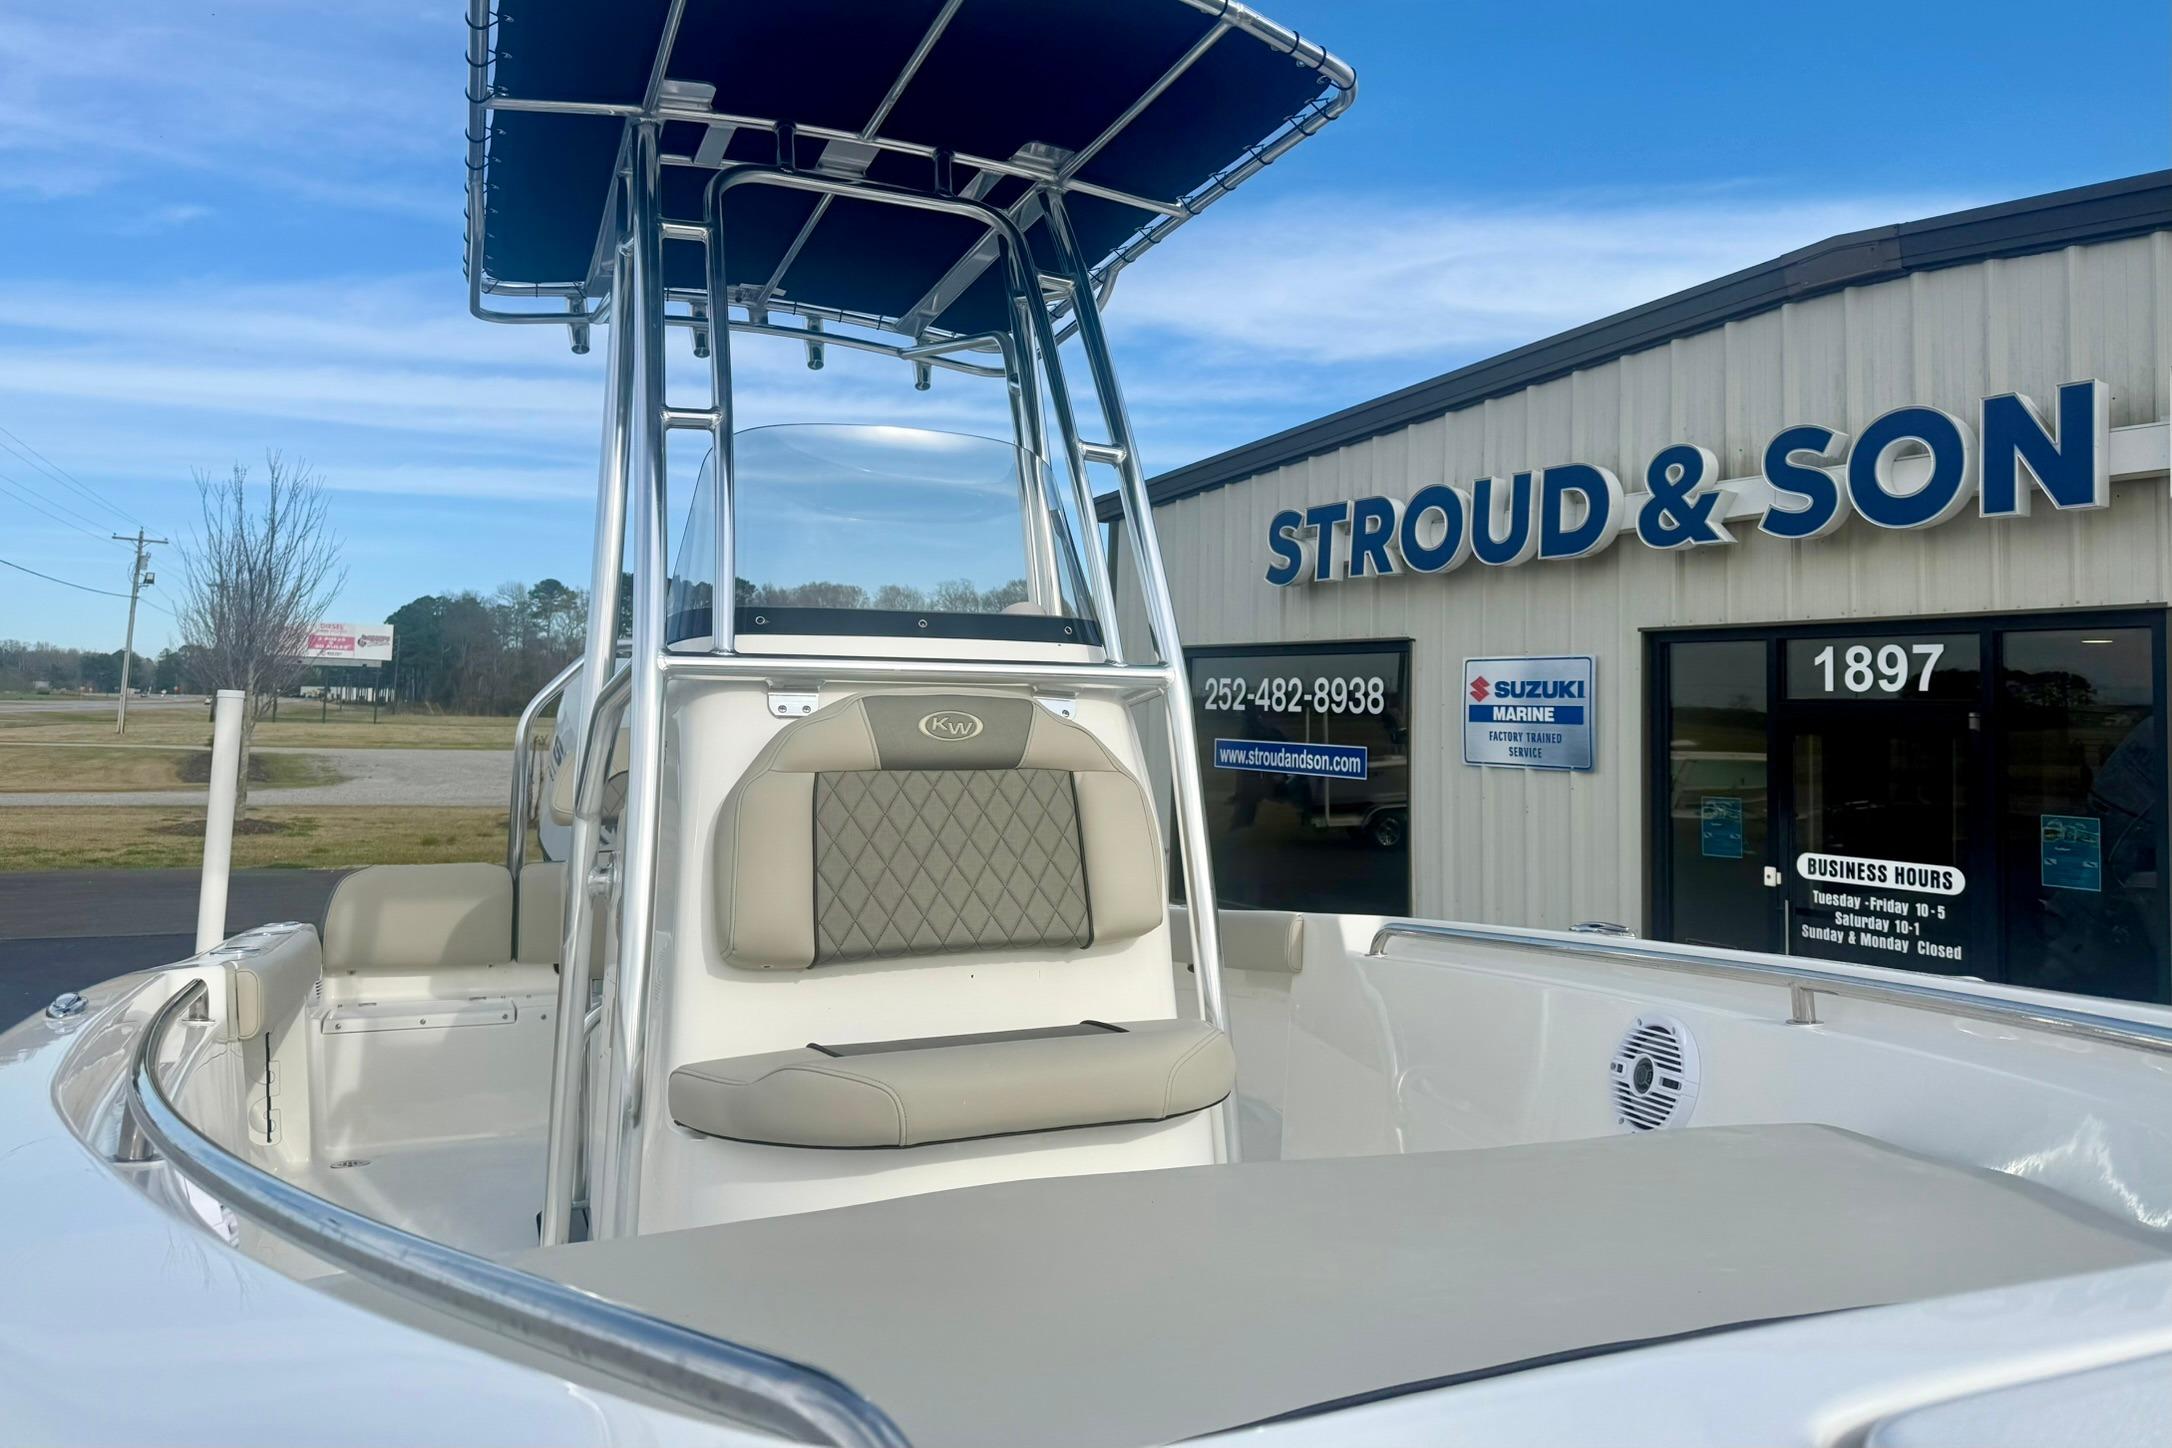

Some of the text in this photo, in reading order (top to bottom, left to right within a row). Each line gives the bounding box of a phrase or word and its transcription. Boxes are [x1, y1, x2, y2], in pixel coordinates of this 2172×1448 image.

[1264, 379, 2105, 586] STROUD & SON
[1814, 643, 1945, 693] 1897
[1204, 676, 1385, 715] 252-482-8938
[1494, 680, 1585, 699] SUZUKI
[1493, 706, 1555, 722] MARINE
[1489, 731, 1562, 744] FACTORY TRAINED
[1220, 747, 1361, 773] www.stroudandson.com
[1508, 746, 1542, 758] SERVICE
[1807, 857, 1953, 890] BUSINESS HOURS
[1812, 890, 1861, 910] Tuesday
[1835, 911, 1920, 936] Saturday 10-1
[1801, 924, 1962, 960] Sunday & Monday Closed
